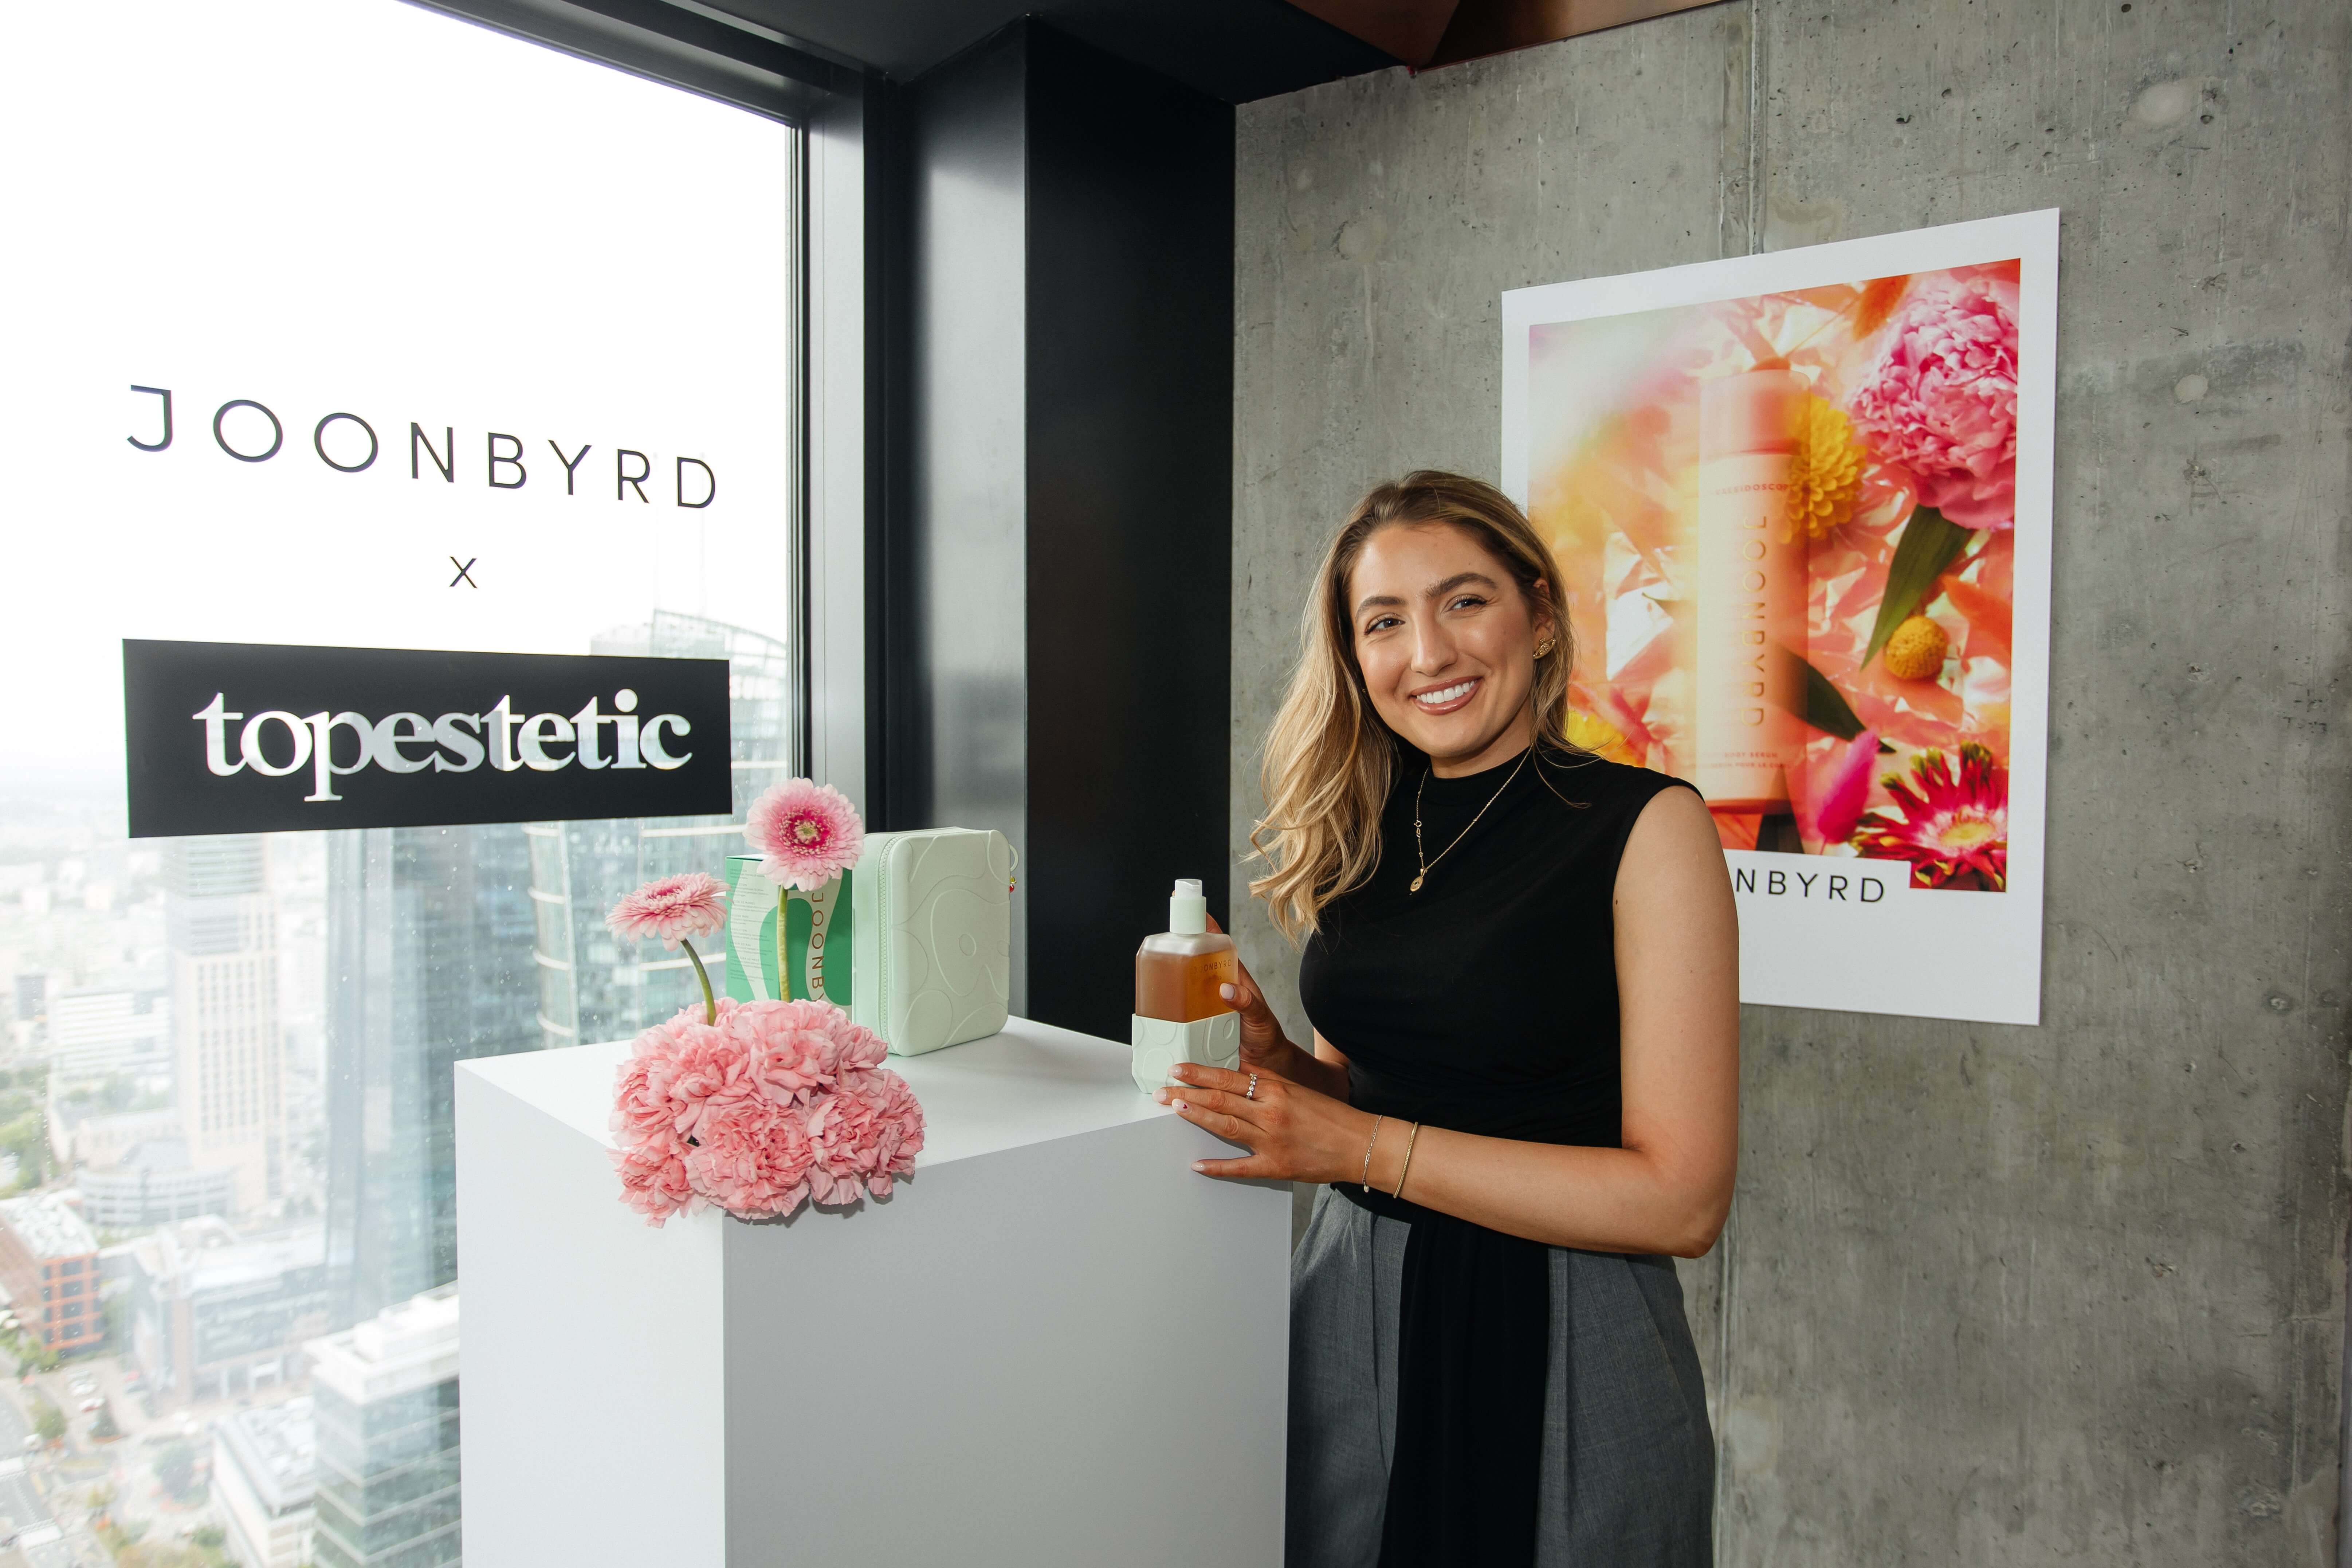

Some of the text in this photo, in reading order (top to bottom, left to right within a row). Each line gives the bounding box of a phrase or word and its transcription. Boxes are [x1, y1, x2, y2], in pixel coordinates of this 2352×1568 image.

[127, 385, 716, 509] JOONBYRD
[1741, 516, 1767, 727] JOONBYRD
[192, 688, 692, 802] topestetic
[1736, 868, 1885, 903] NBYRD
[812, 892, 824, 1002] JOONBY
